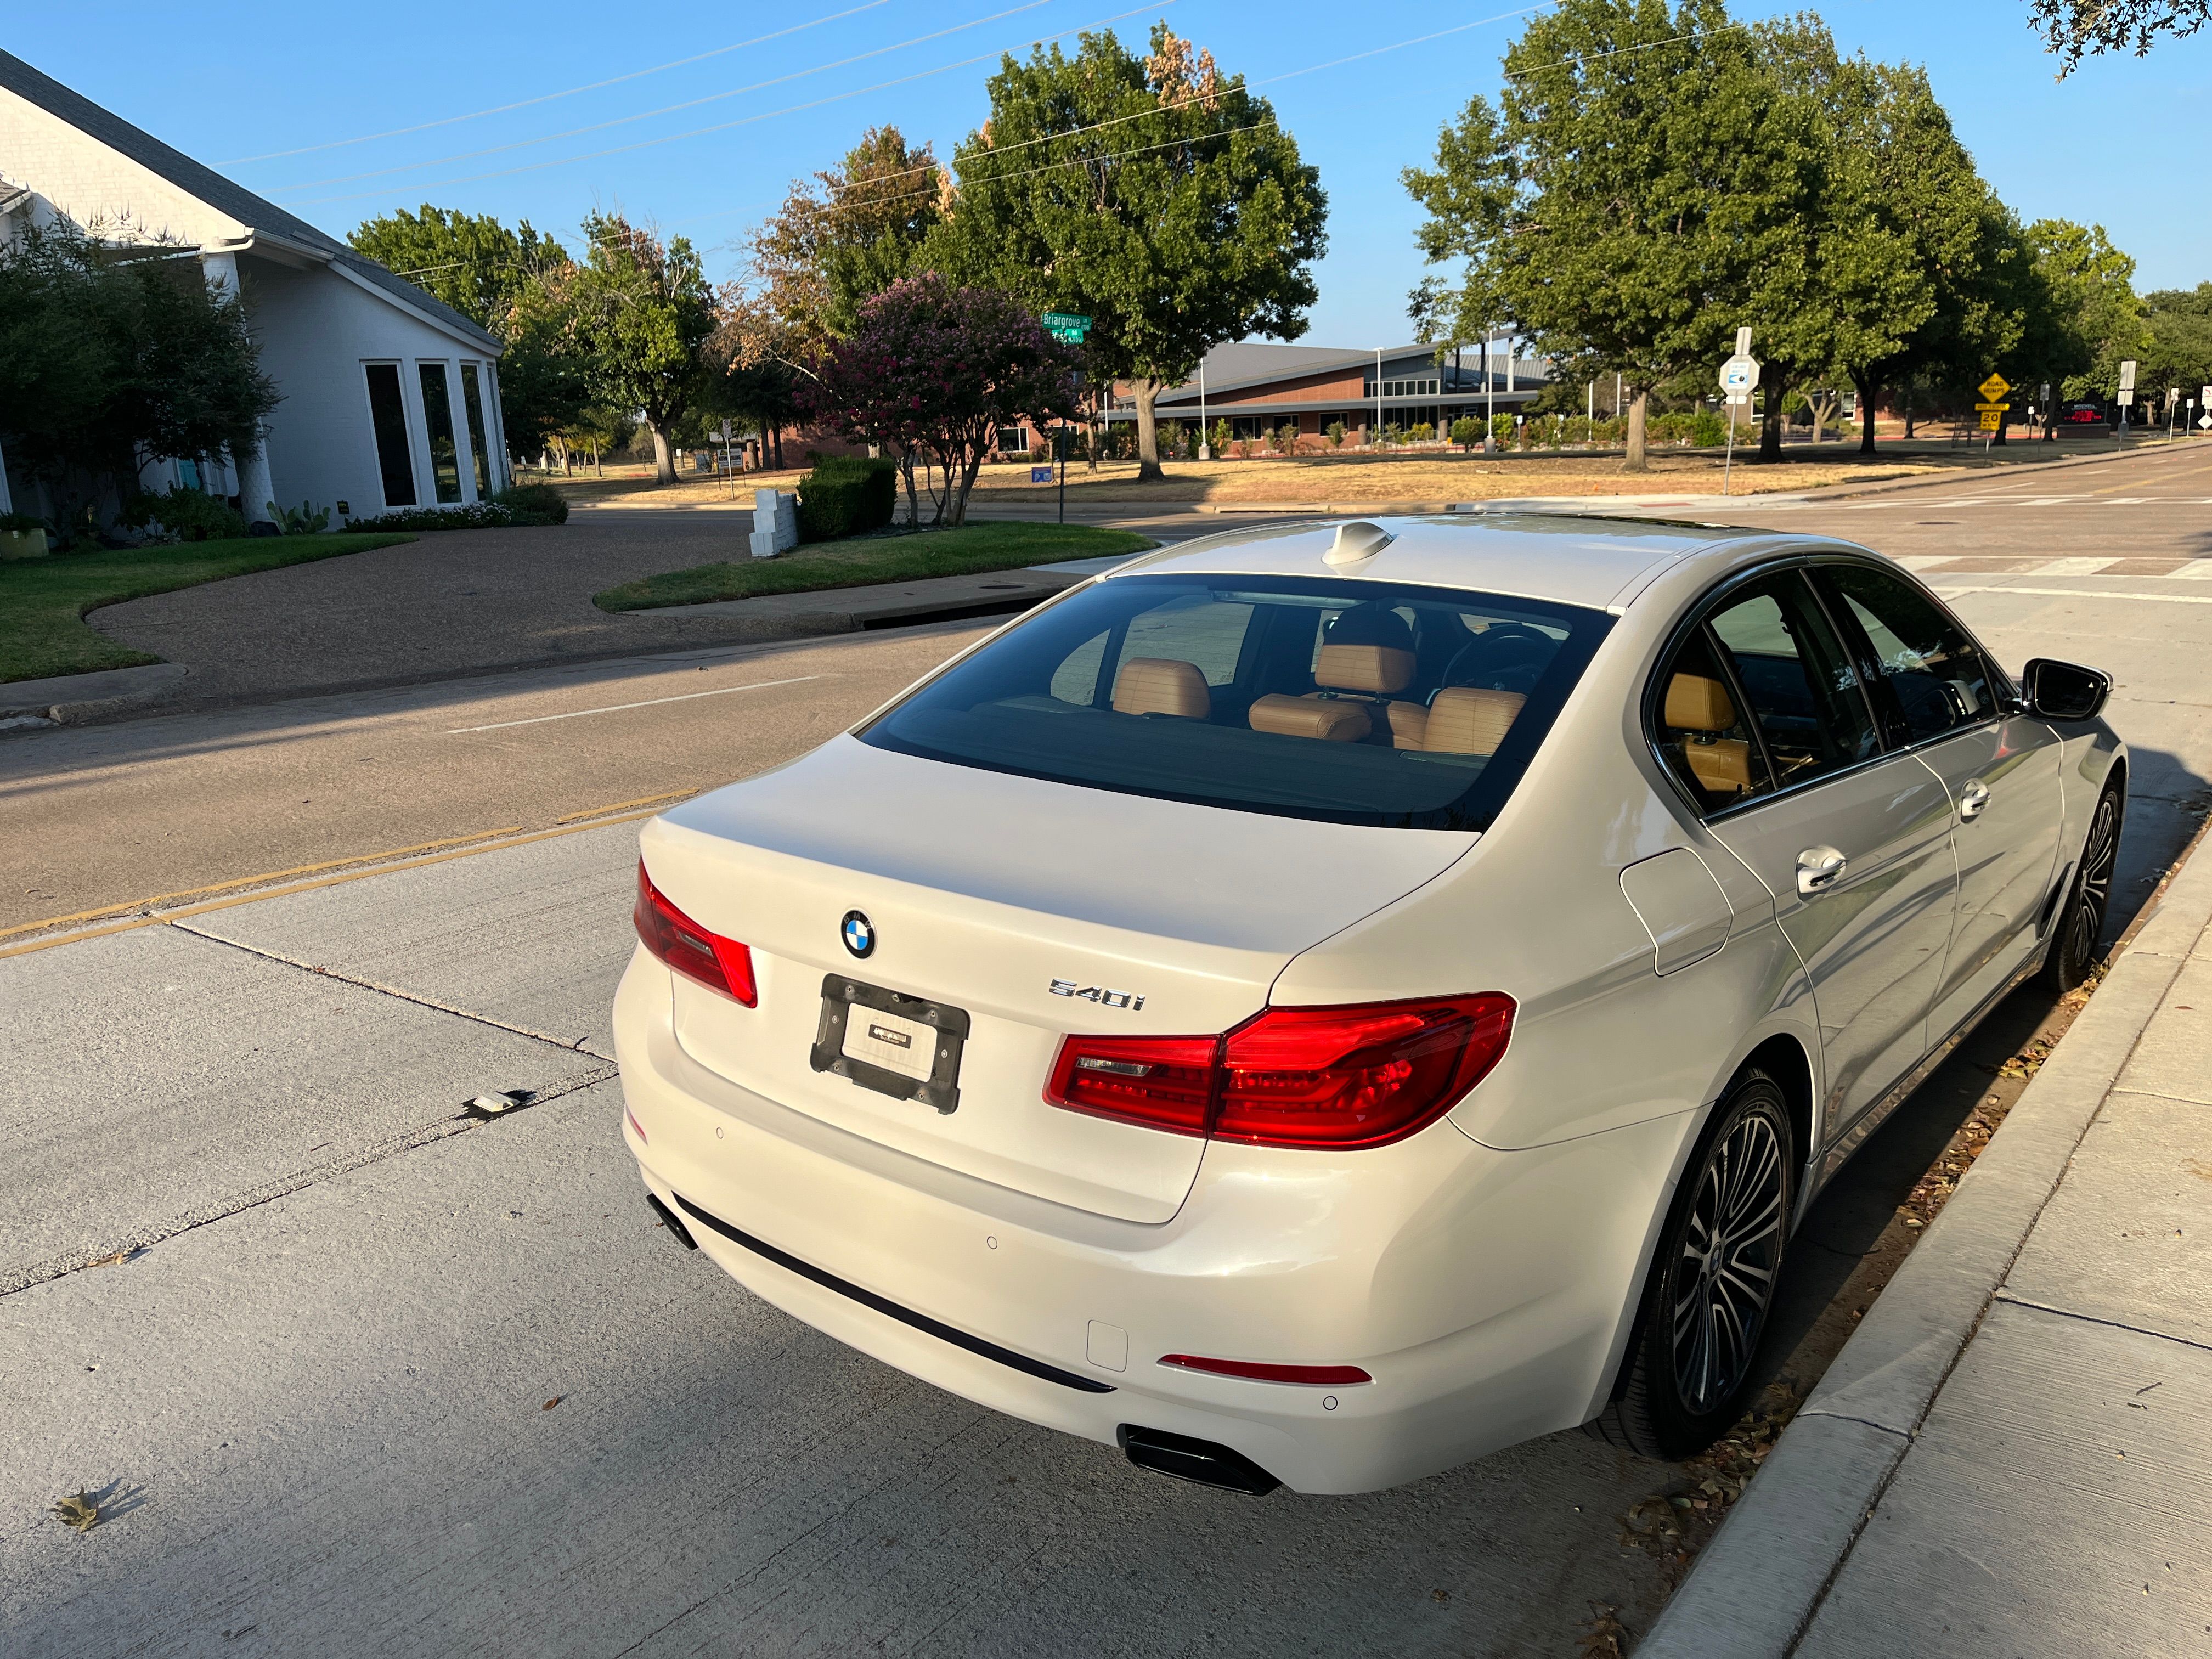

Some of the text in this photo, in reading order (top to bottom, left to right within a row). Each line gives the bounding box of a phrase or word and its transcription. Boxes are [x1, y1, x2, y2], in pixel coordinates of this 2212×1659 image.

[1043, 313, 1080, 329] Briargrove
[1983, 413, 1999, 422] 20
[843, 911, 872, 929] BMW
[1049, 977, 1146, 1011] 540i
